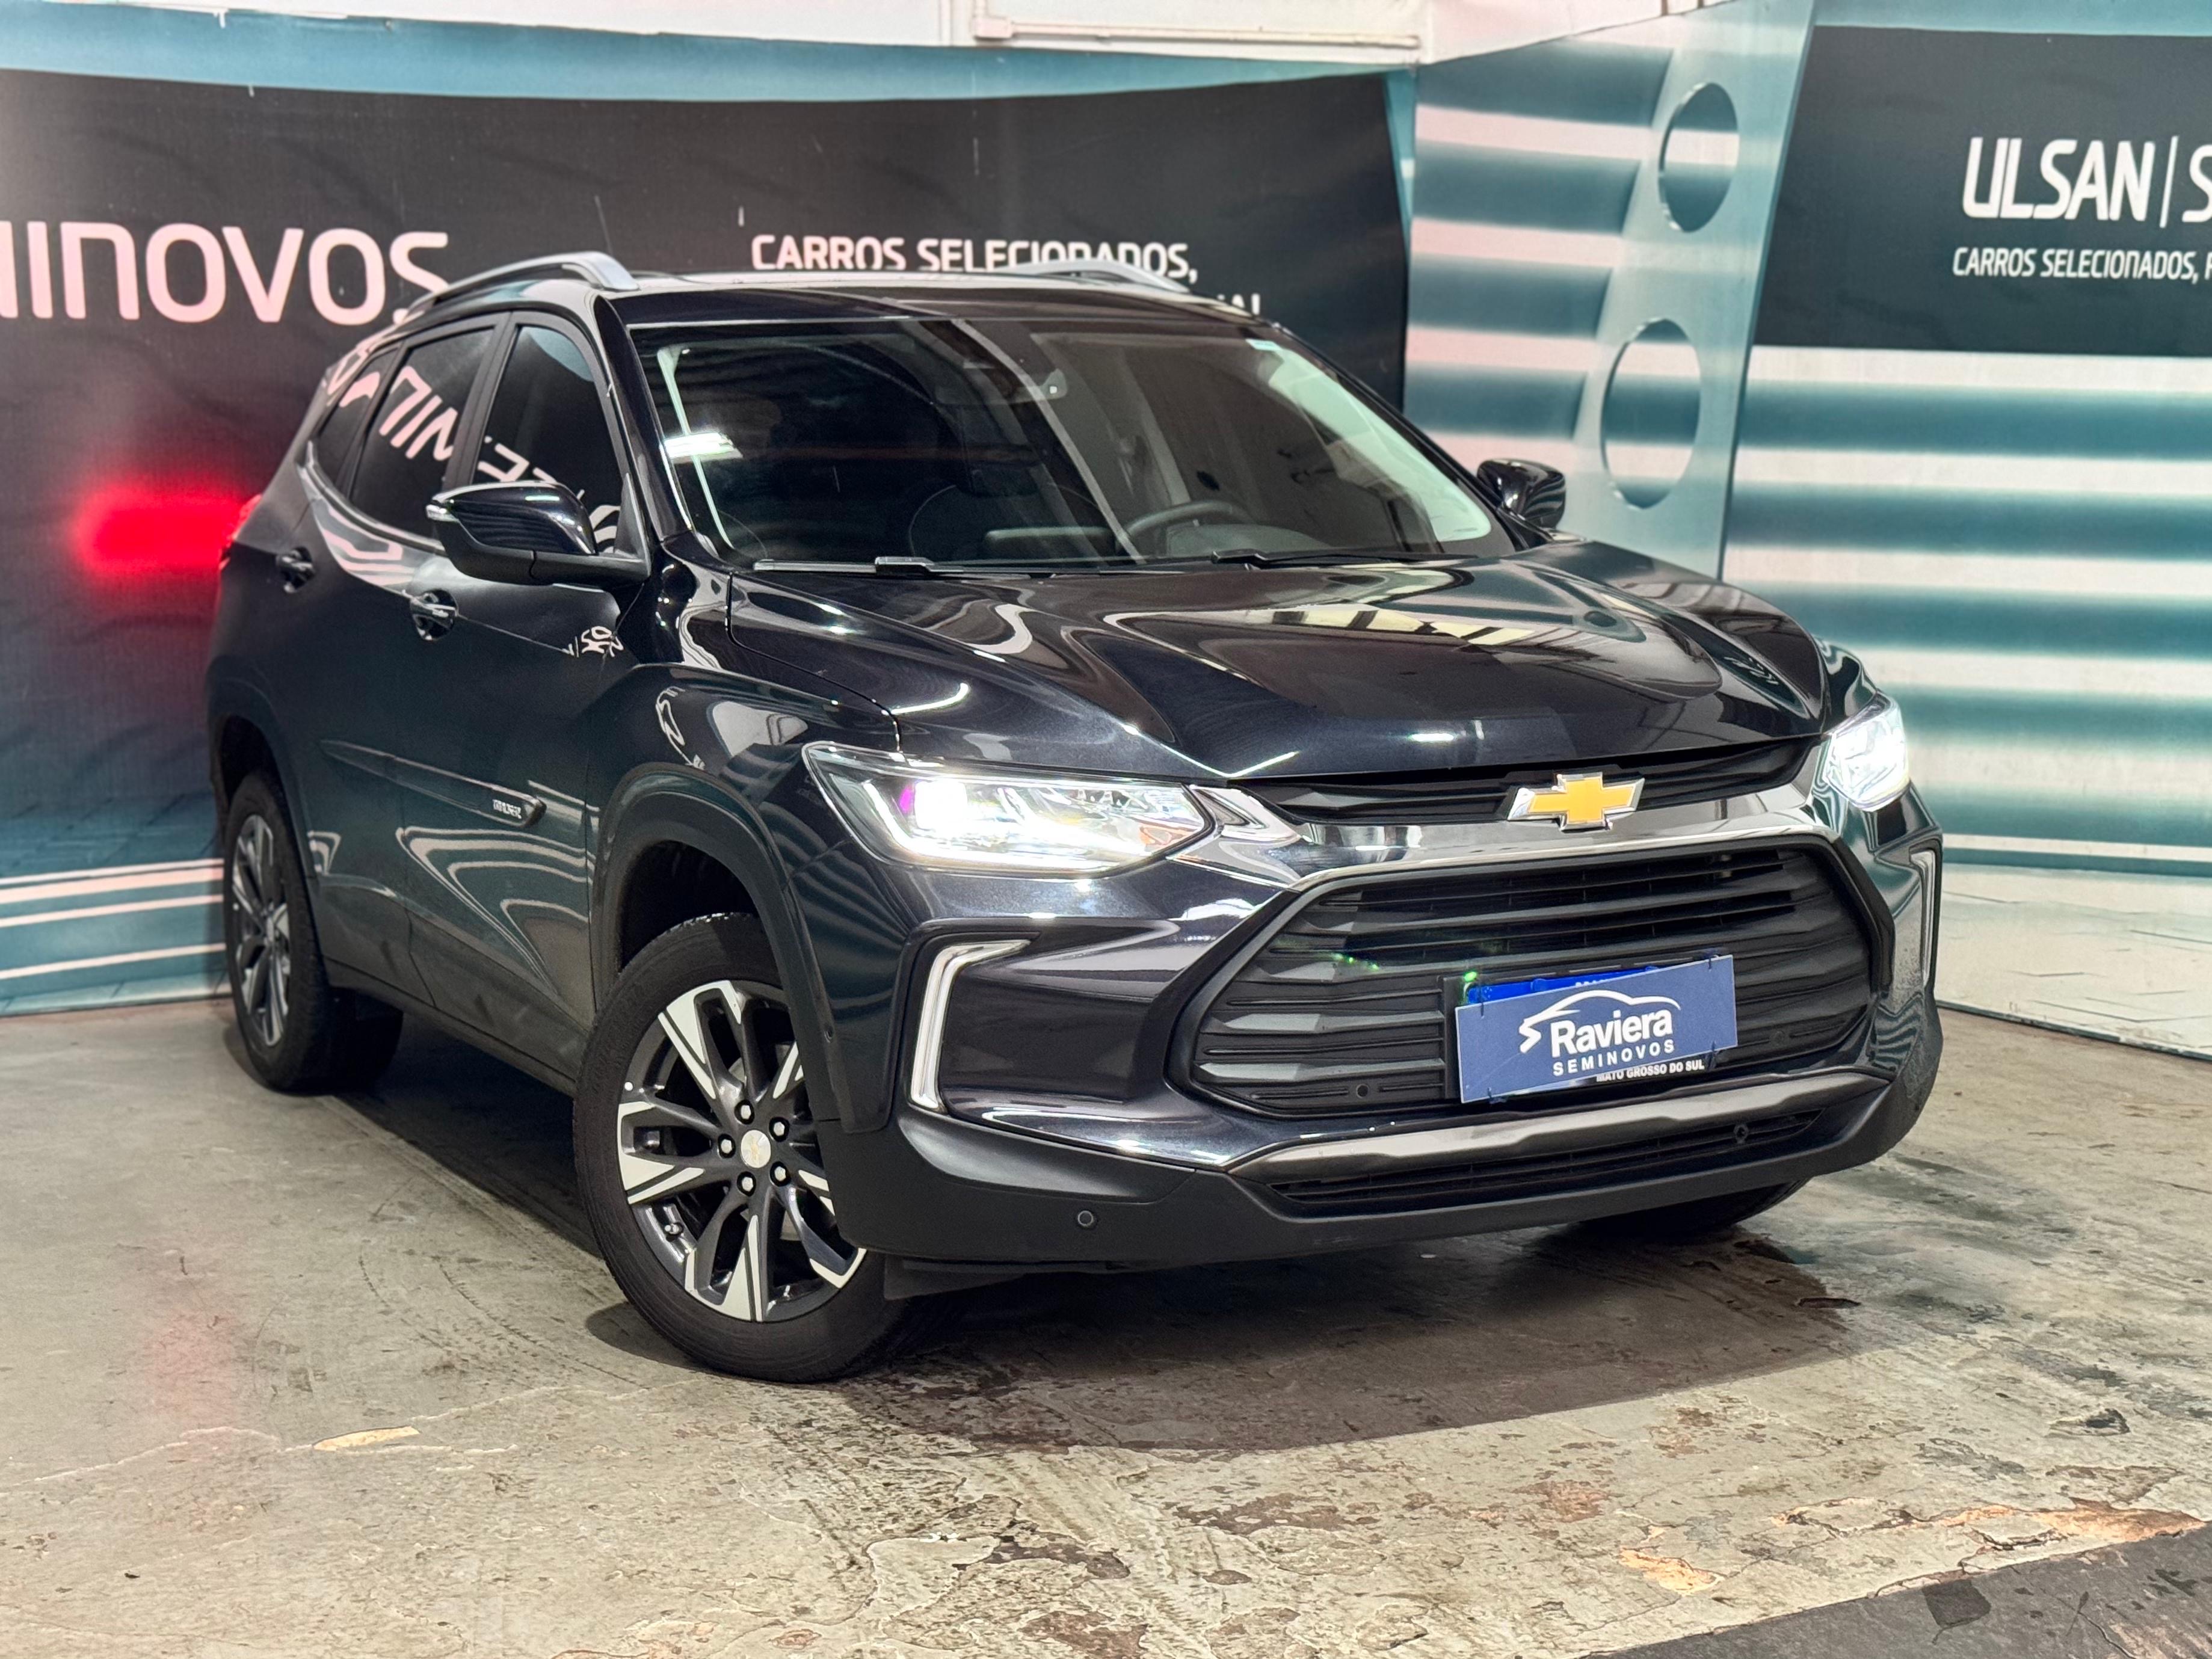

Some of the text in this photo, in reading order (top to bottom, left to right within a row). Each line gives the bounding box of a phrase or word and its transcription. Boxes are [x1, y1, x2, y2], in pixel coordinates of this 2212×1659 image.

[1963, 137, 2155, 221] ULSAN
[751, 234, 907, 270] CARROS
[1953, 247, 2037, 277] CARROS
[2040, 248, 2199, 285] SELECIONADOS,
[0, 221, 449, 325] INOVOS
[1550, 1009, 1674, 1058] Raviera
[1553, 1039, 1674, 1077] SEMINOVOS
[1626, 1063, 1668, 1080] GROSSO
[1669, 1061, 1684, 1073] DO
[1685, 1059, 1705, 1072] SUL
